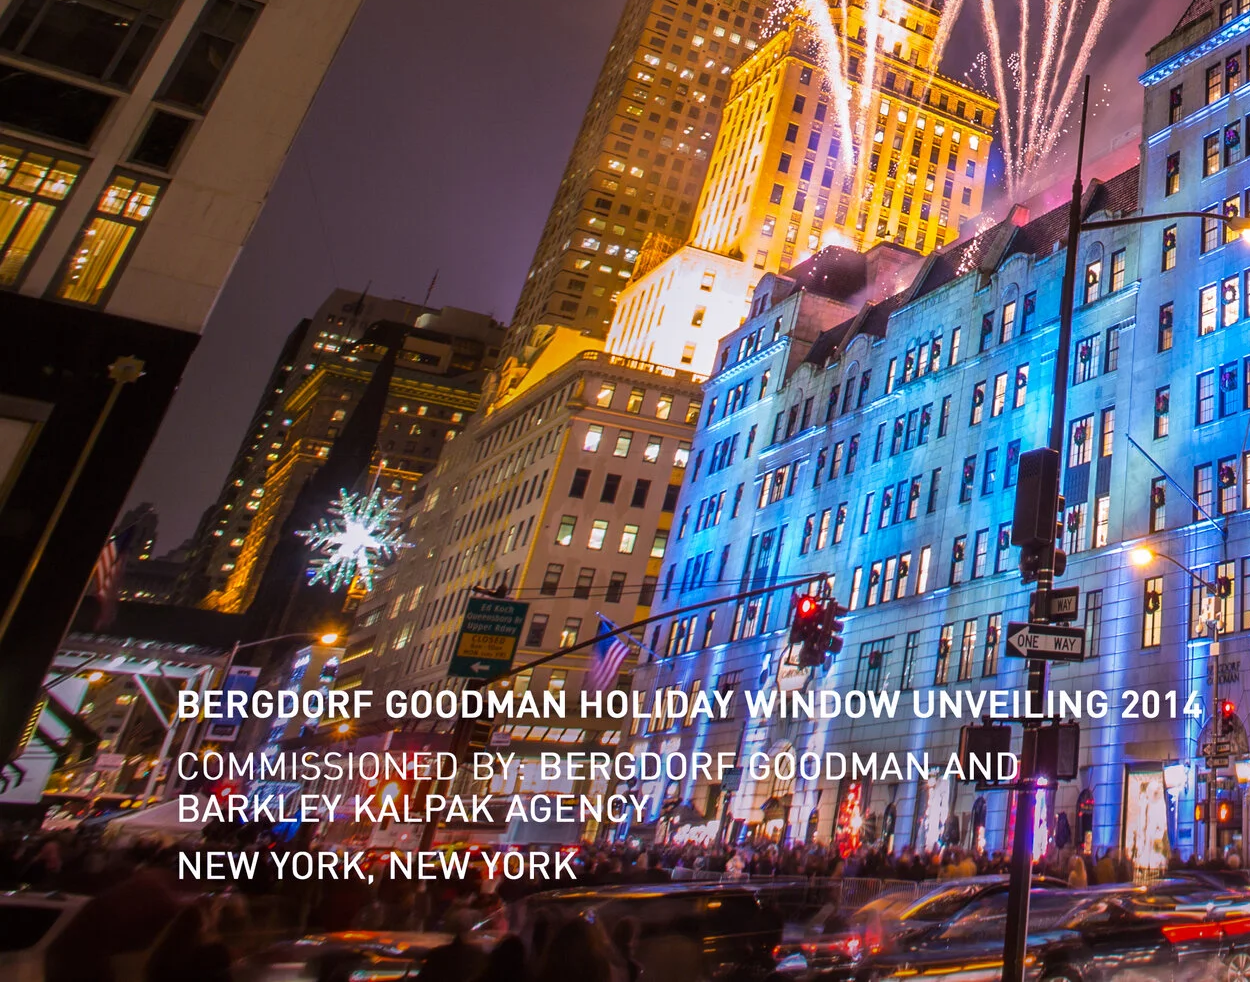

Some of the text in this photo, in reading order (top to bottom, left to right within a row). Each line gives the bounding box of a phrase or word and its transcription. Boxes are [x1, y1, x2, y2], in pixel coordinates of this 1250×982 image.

[480, 603, 514, 613] Ed Koch
[1057, 598, 1072, 612] WAY
[467, 622, 492, 631] Upper
[472, 635, 506, 644] CLOSED
[1017, 634, 1076, 651] ONE WAY
